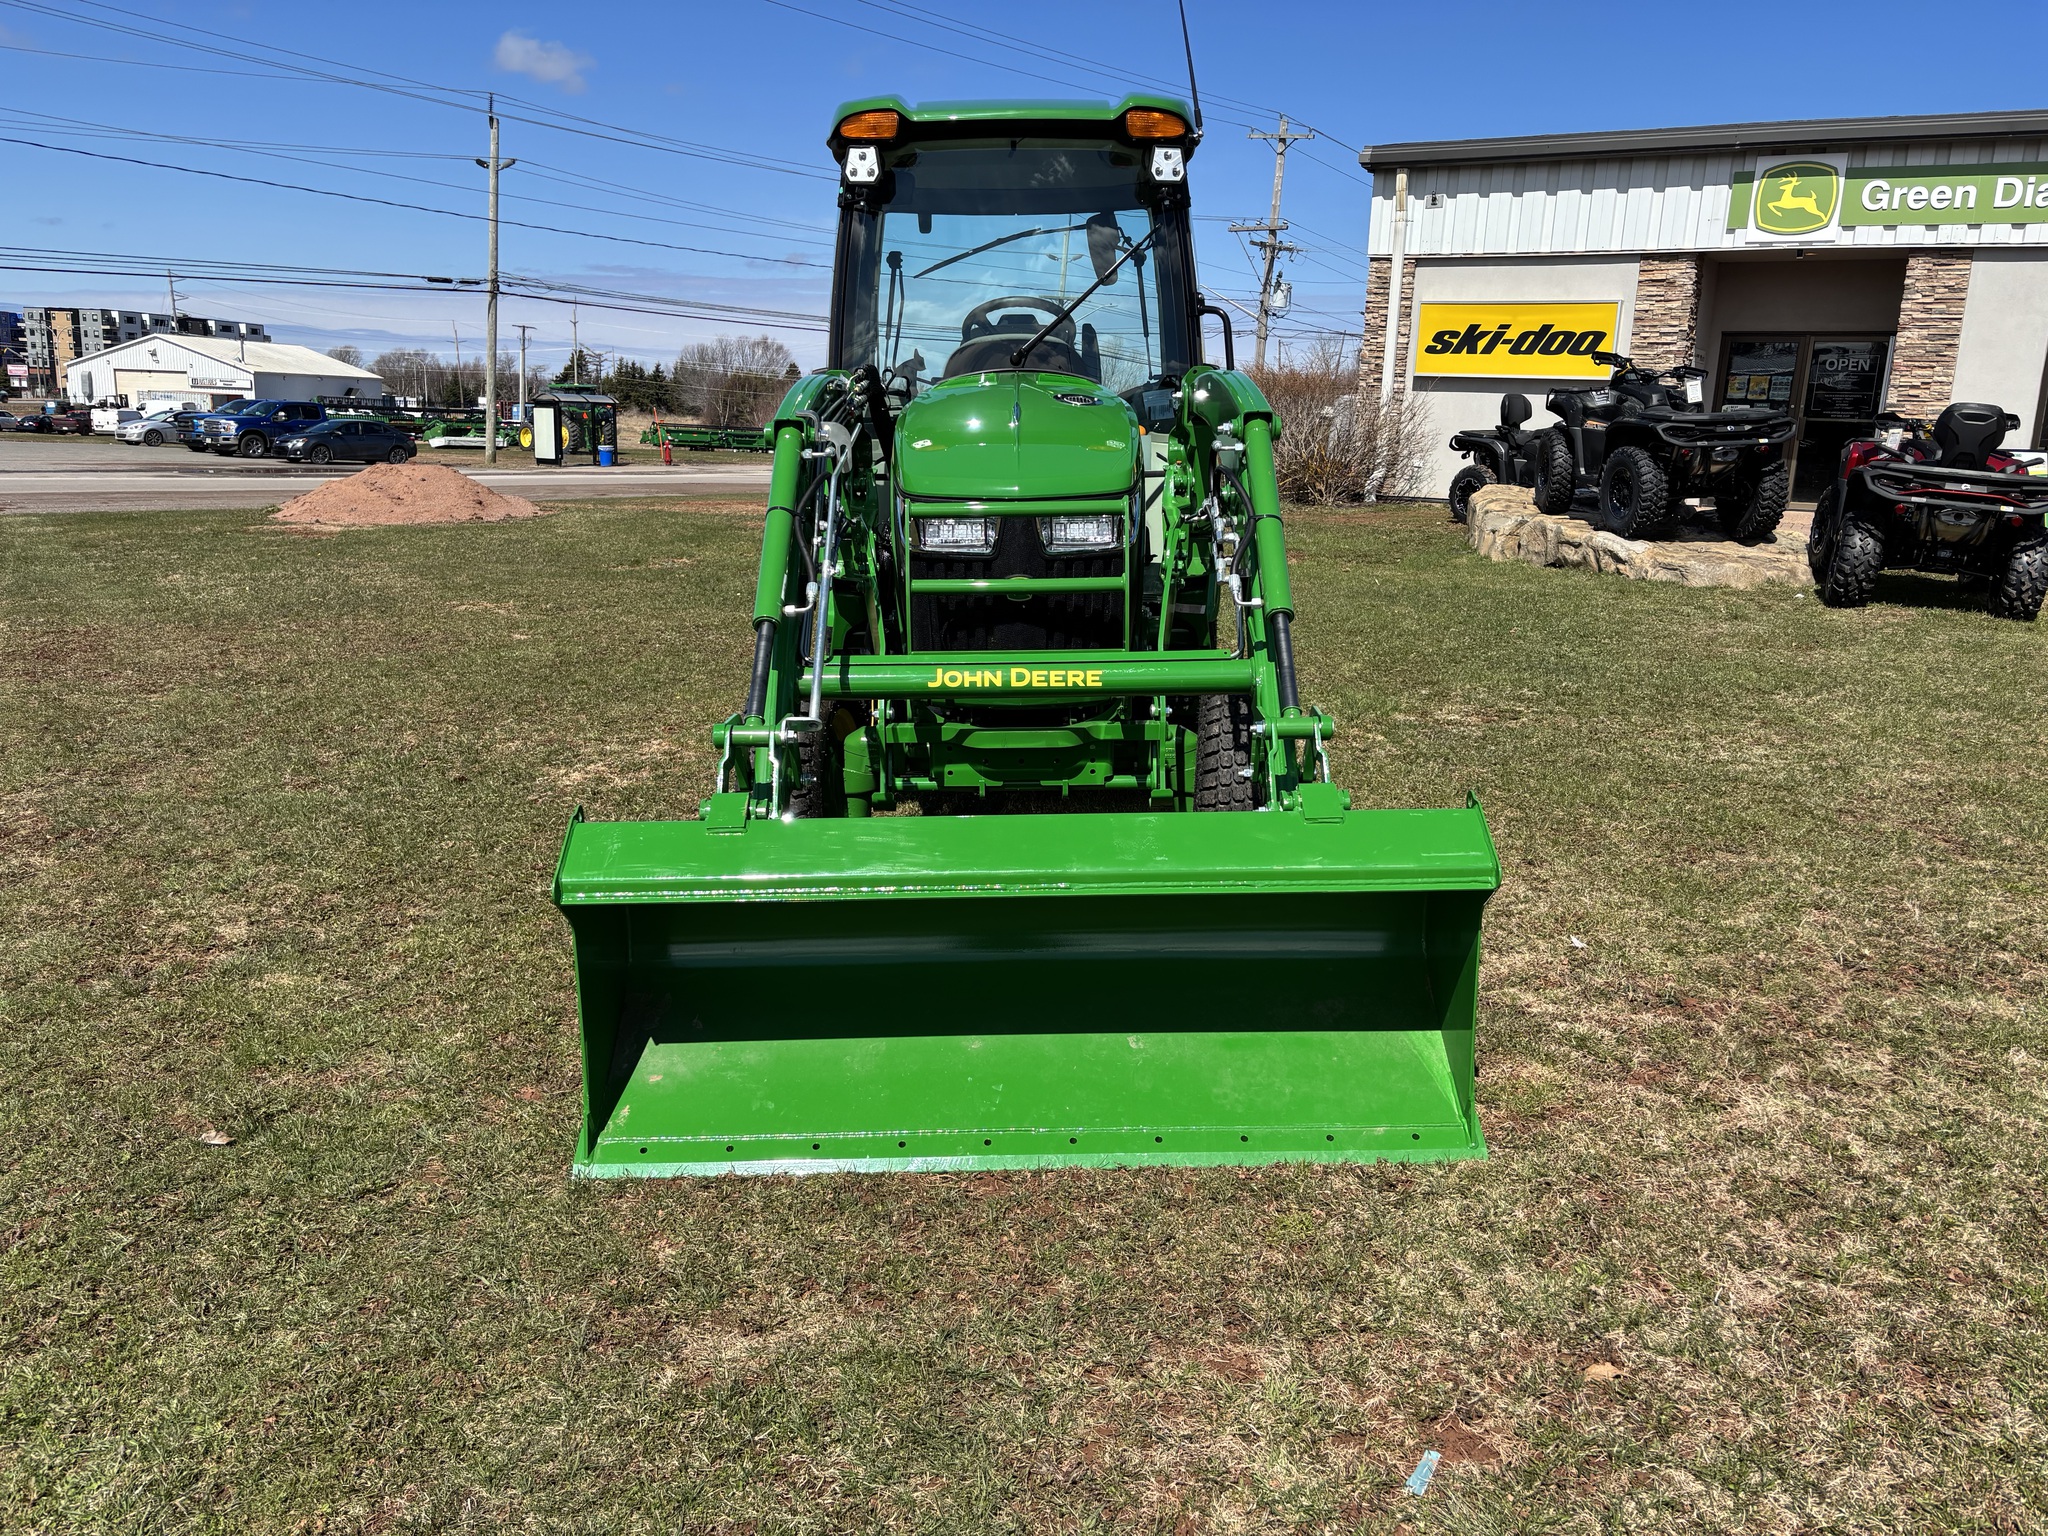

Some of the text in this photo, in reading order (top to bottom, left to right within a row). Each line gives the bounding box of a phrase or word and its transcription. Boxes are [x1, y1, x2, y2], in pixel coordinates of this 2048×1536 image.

[1861, 176, 2048, 211] Green Dia
[1424, 324, 1607, 356] ski-doo
[1825, 358, 1870, 371] OPEN
[927, 668, 1103, 688] JOHN DEERE
